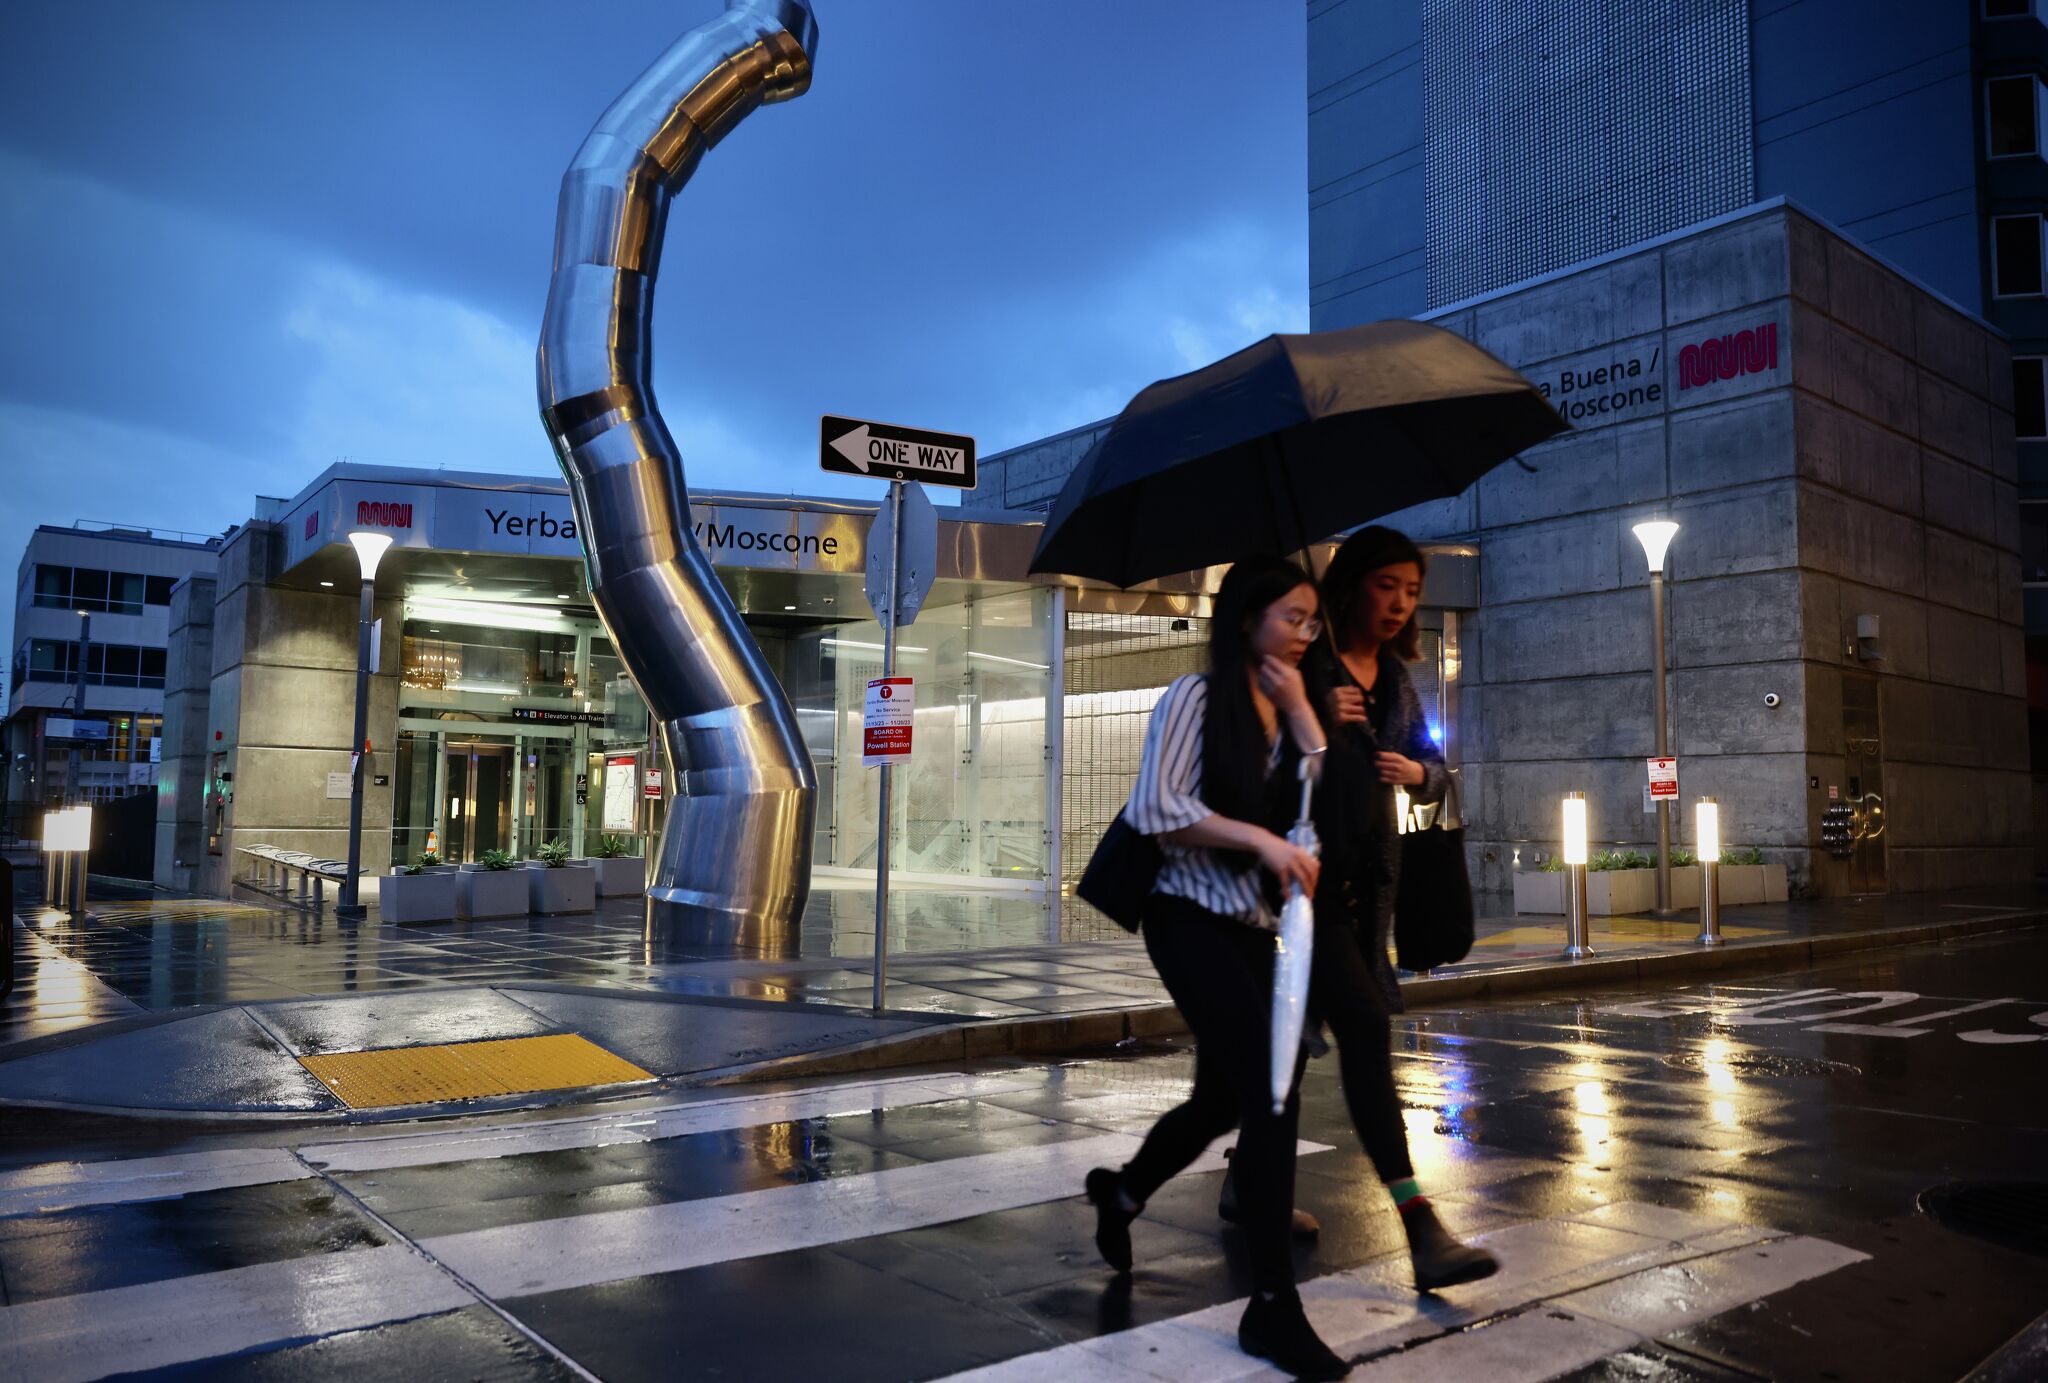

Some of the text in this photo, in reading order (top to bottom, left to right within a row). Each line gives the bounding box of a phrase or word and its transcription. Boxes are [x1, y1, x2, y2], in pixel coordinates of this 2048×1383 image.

[1560, 358, 1642, 394] Buena
[868, 439, 960, 470] ONE WAY
[485, 508, 578, 540] Yerba
